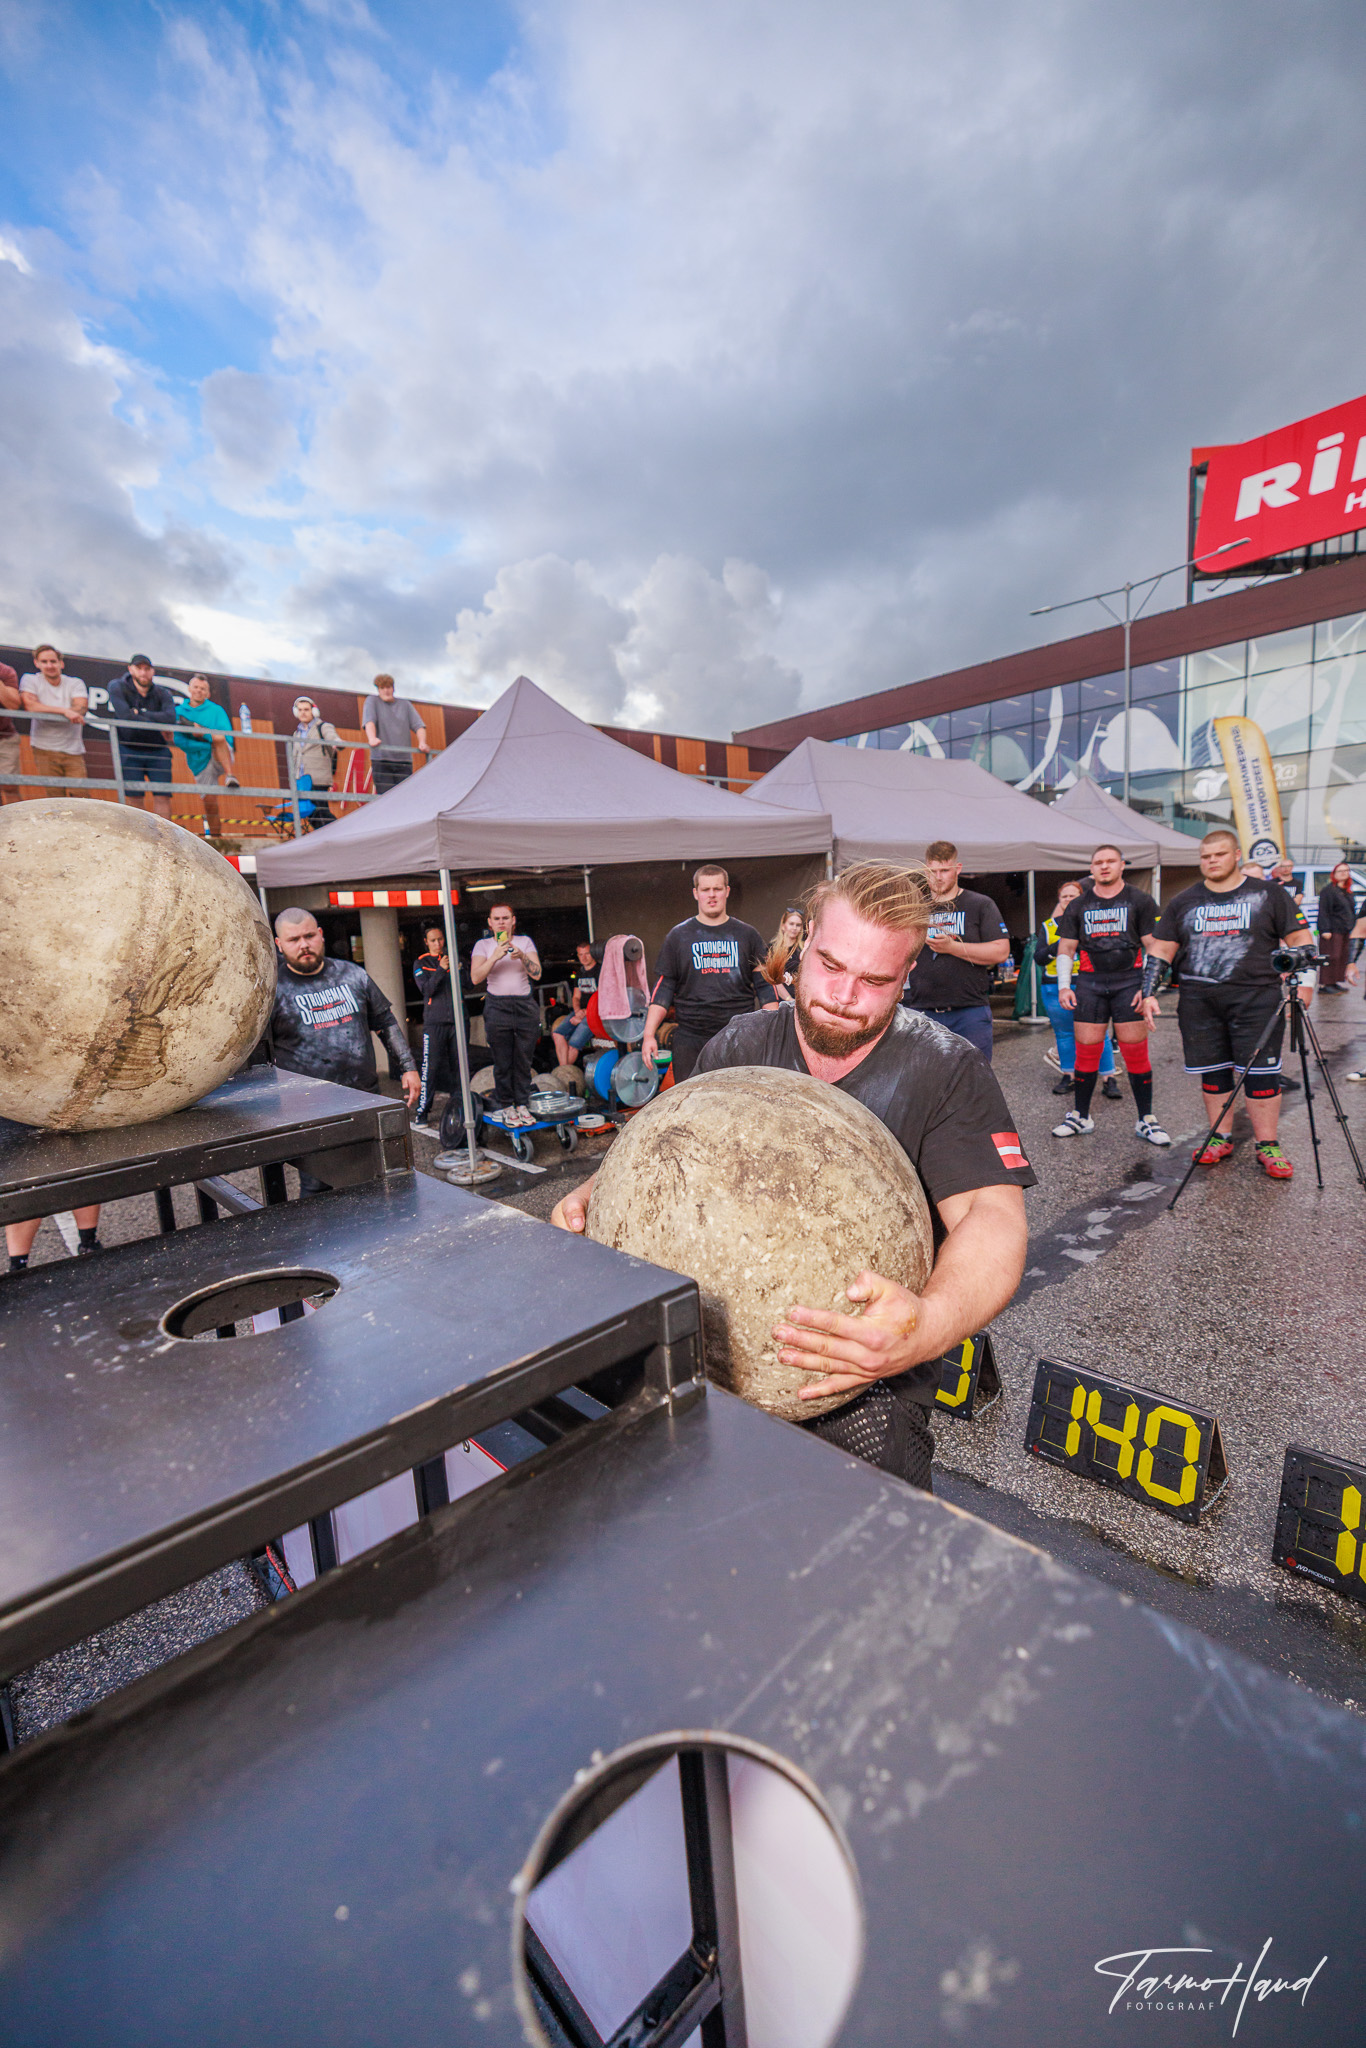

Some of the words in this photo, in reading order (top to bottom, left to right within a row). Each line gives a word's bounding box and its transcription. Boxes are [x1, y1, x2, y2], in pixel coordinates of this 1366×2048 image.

[1234, 431, 1366, 522] Ri
[1084, 907, 1127, 924] STRONGMAN
[1196, 902, 1251, 921] STRONGMAN
[692, 941, 739, 958] STRONGMAN
[295, 984, 357, 1009] STRONGMAN
[299, 1001, 359, 1025] STRONGWOMAN
[1065, 1384, 1201, 1507] 140
[1295, 1564, 1308, 1572] JVD
[1307, 1568, 1335, 1584] PRODUCTS
